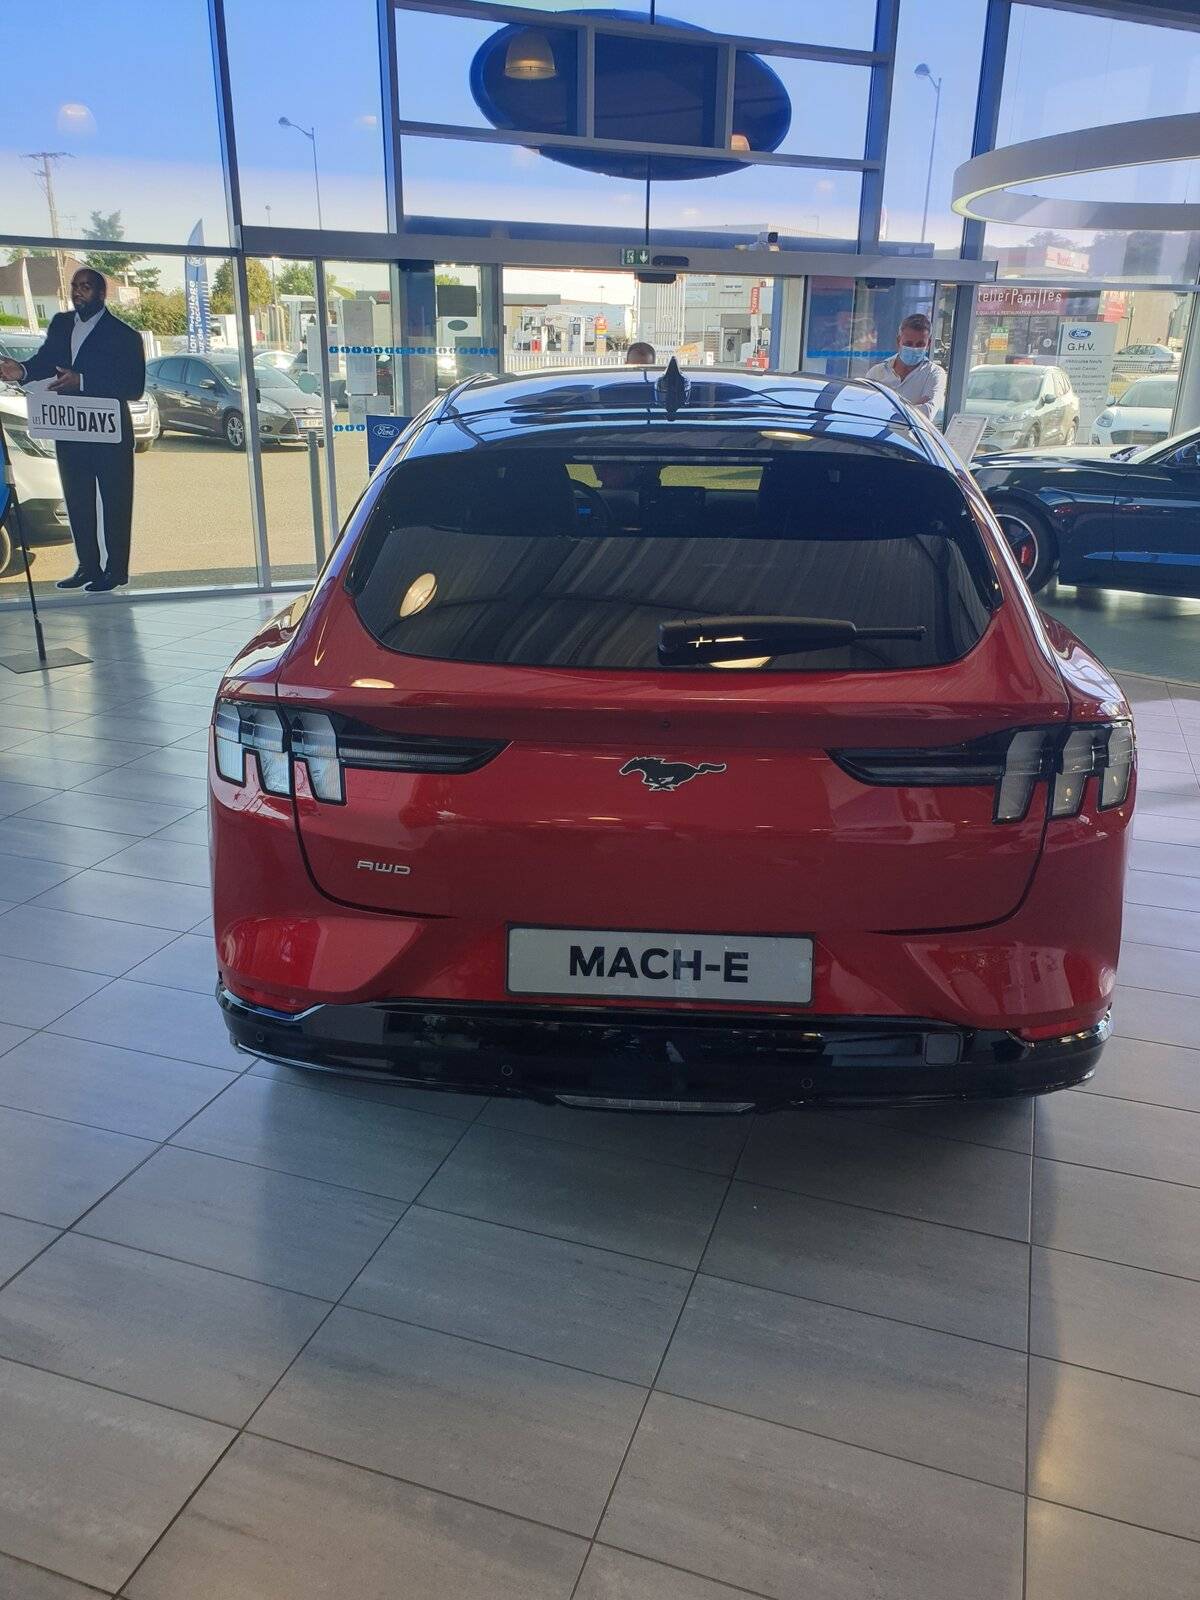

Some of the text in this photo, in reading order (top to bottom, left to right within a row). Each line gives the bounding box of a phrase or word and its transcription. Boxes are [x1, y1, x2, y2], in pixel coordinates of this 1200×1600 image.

[1067, 342, 1095, 351] G.H.V.
[41, 404, 75, 427] FORD
[76, 411, 116, 433] DAYS
[376, 425, 396, 436] Ford
[357, 860, 411, 875] AWD
[569, 945, 749, 983] MACH-E
